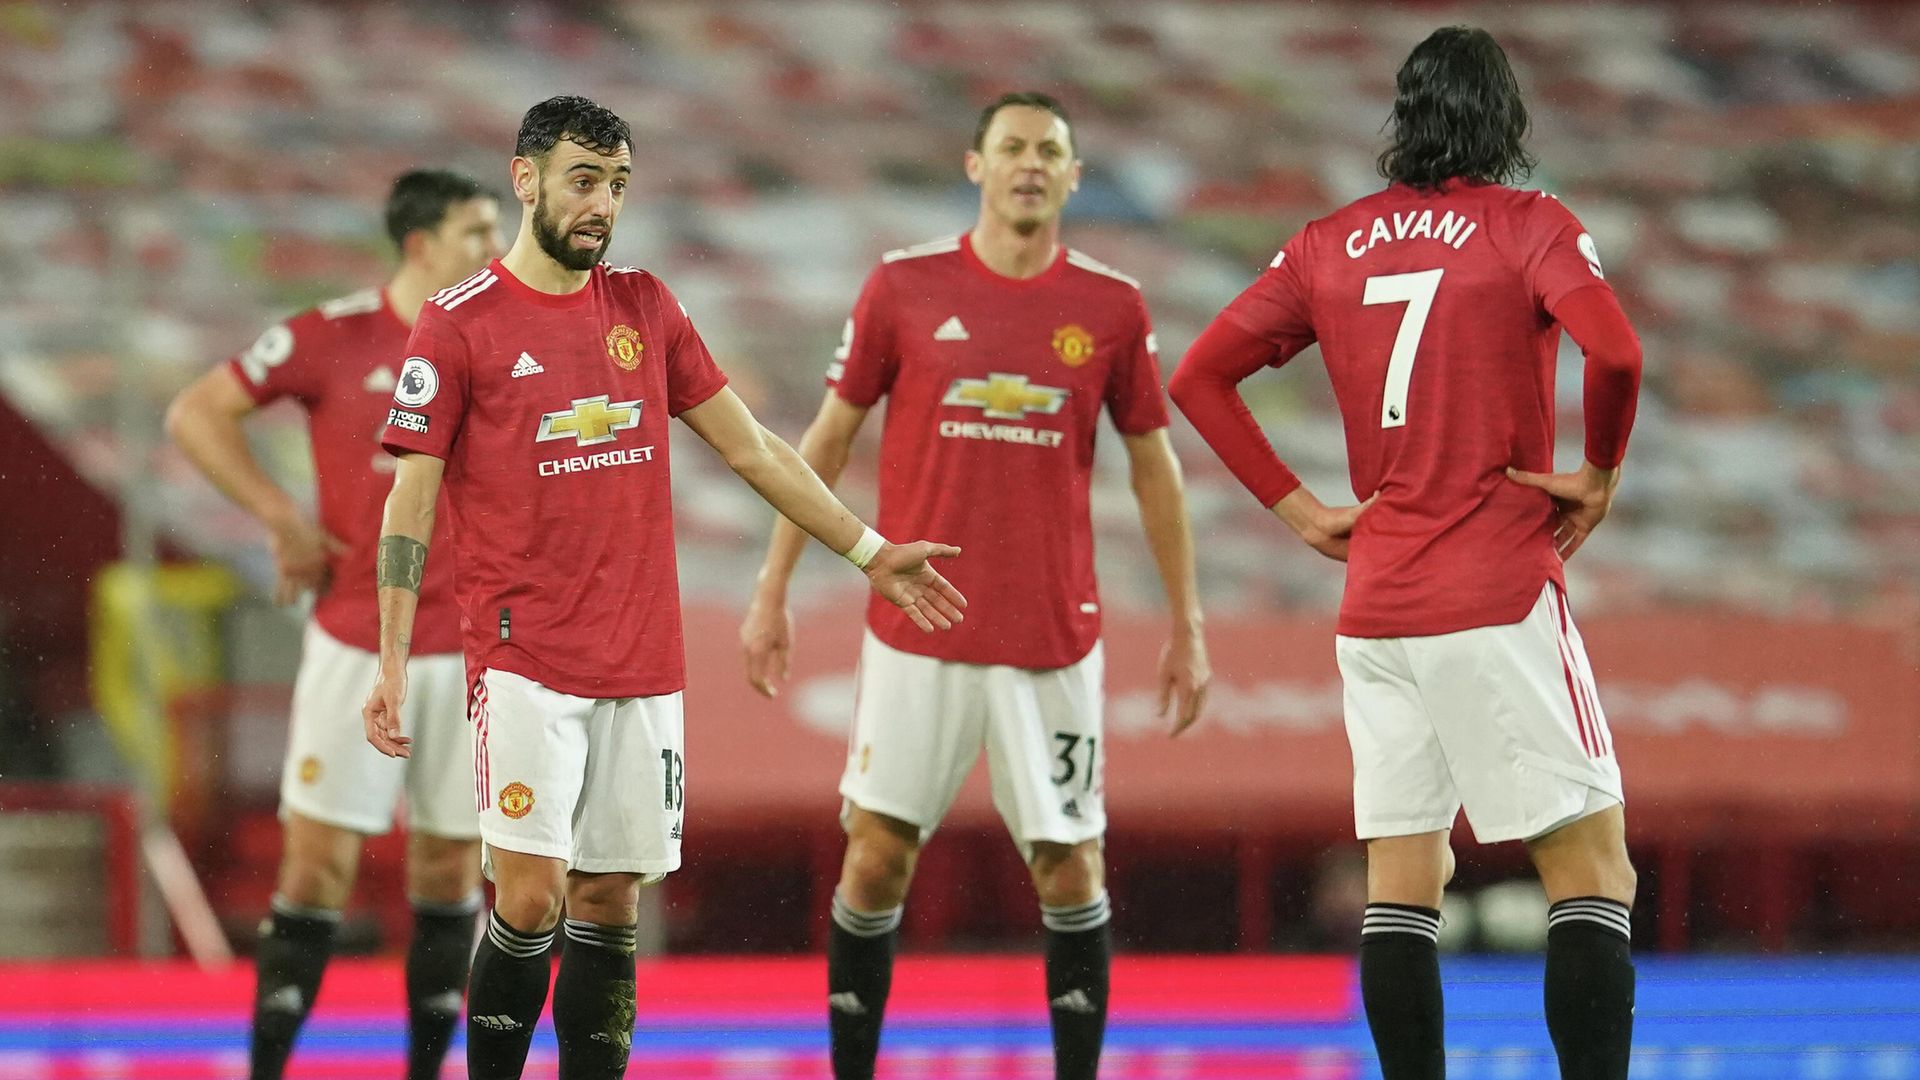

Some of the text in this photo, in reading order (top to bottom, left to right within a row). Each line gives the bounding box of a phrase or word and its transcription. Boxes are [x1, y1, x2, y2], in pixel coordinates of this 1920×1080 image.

[1345, 209, 1477, 259] CAVANI
[1362, 268, 1444, 429] 7
[511, 365, 544, 378] adidas
[397, 410, 426, 425] room
[939, 421, 1064, 449] CHEVROLET
[538, 446, 655, 477] CHEVROLET
[660, 748, 683, 813] 18
[1051, 731, 1096, 792] 31
